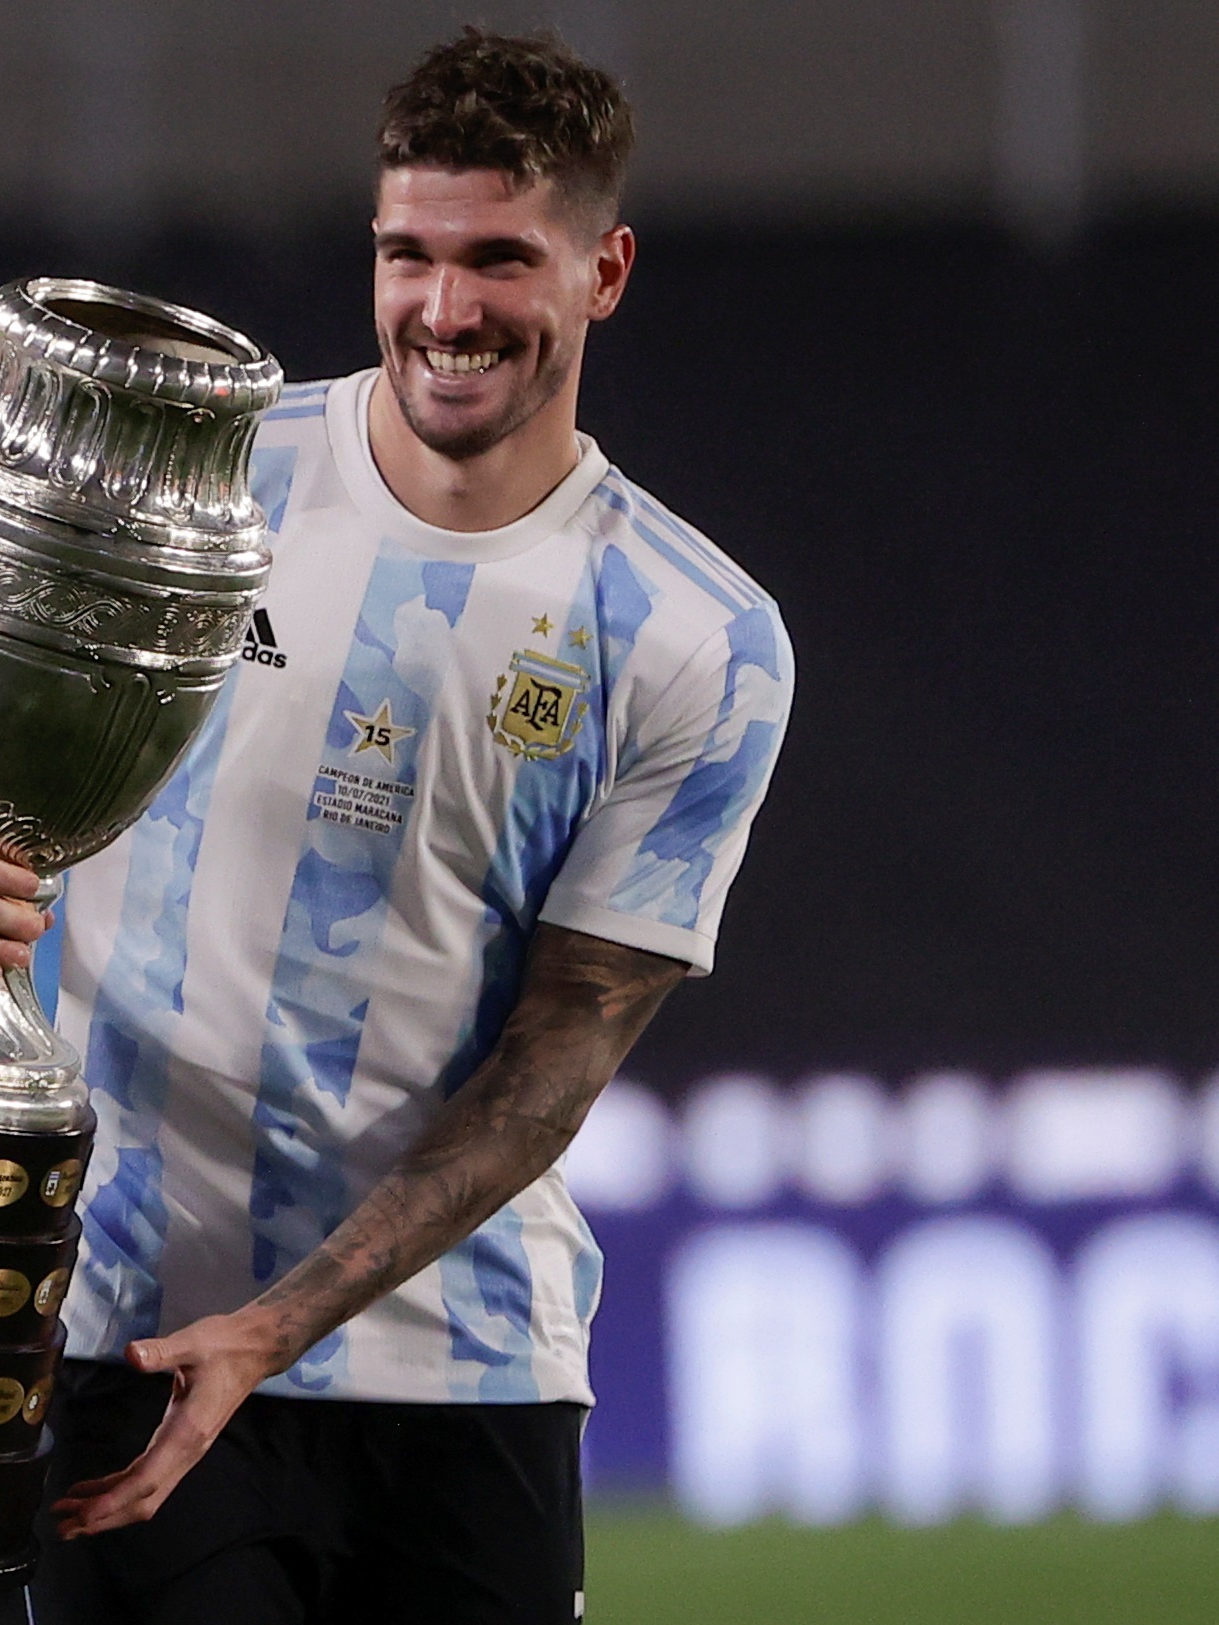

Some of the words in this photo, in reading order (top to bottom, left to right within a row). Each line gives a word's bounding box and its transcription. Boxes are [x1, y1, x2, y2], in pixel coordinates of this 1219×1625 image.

[242, 643, 287, 669] das
[510, 677, 562, 731] AFA
[365, 725, 392, 746] 15
